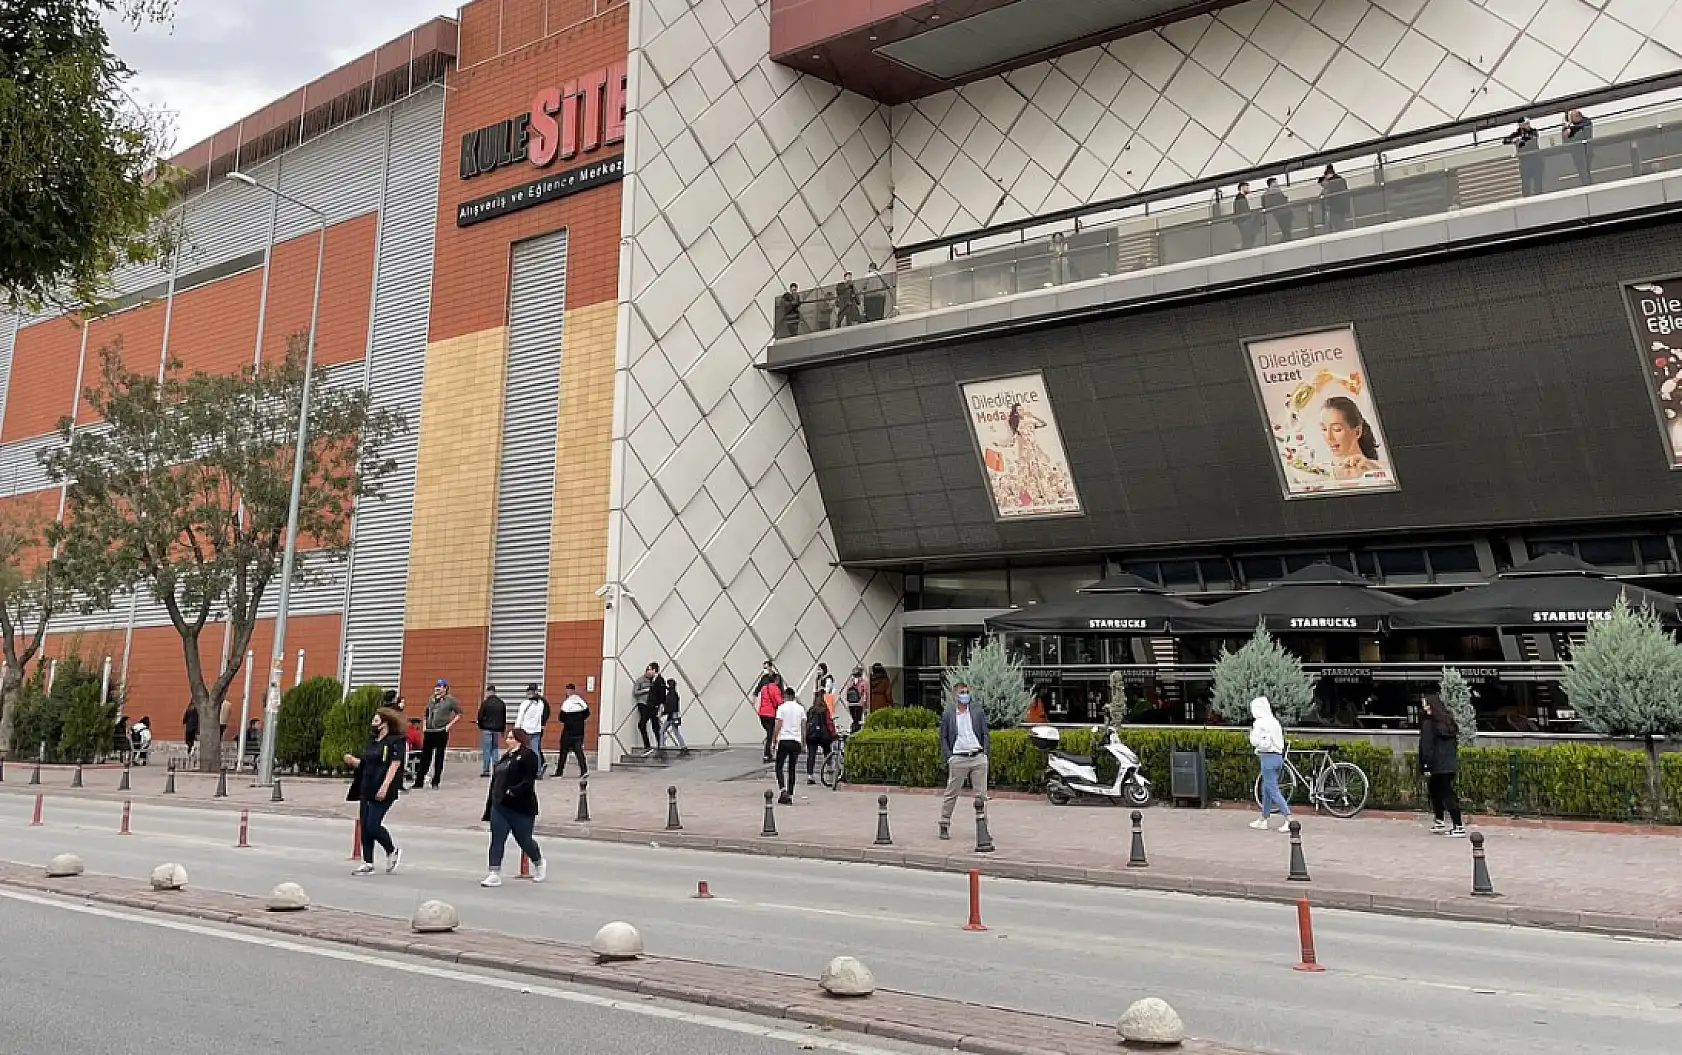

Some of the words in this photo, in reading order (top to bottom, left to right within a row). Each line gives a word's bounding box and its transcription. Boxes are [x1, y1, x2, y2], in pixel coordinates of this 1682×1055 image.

[460, 112, 531, 179] KULE
[511, 192, 523, 203] ve
[1258, 347, 1343, 370] Dilediğince
[1263, 369, 1302, 384] Lezzet
[971, 390, 1038, 410] Dilediğince
[976, 410, 1007, 423] Moda
[1290, 617, 1357, 628] STARBUCKS
[1532, 611, 1612, 621] STARBUCKS
[1089, 619, 1147, 628] STARBUCKS
